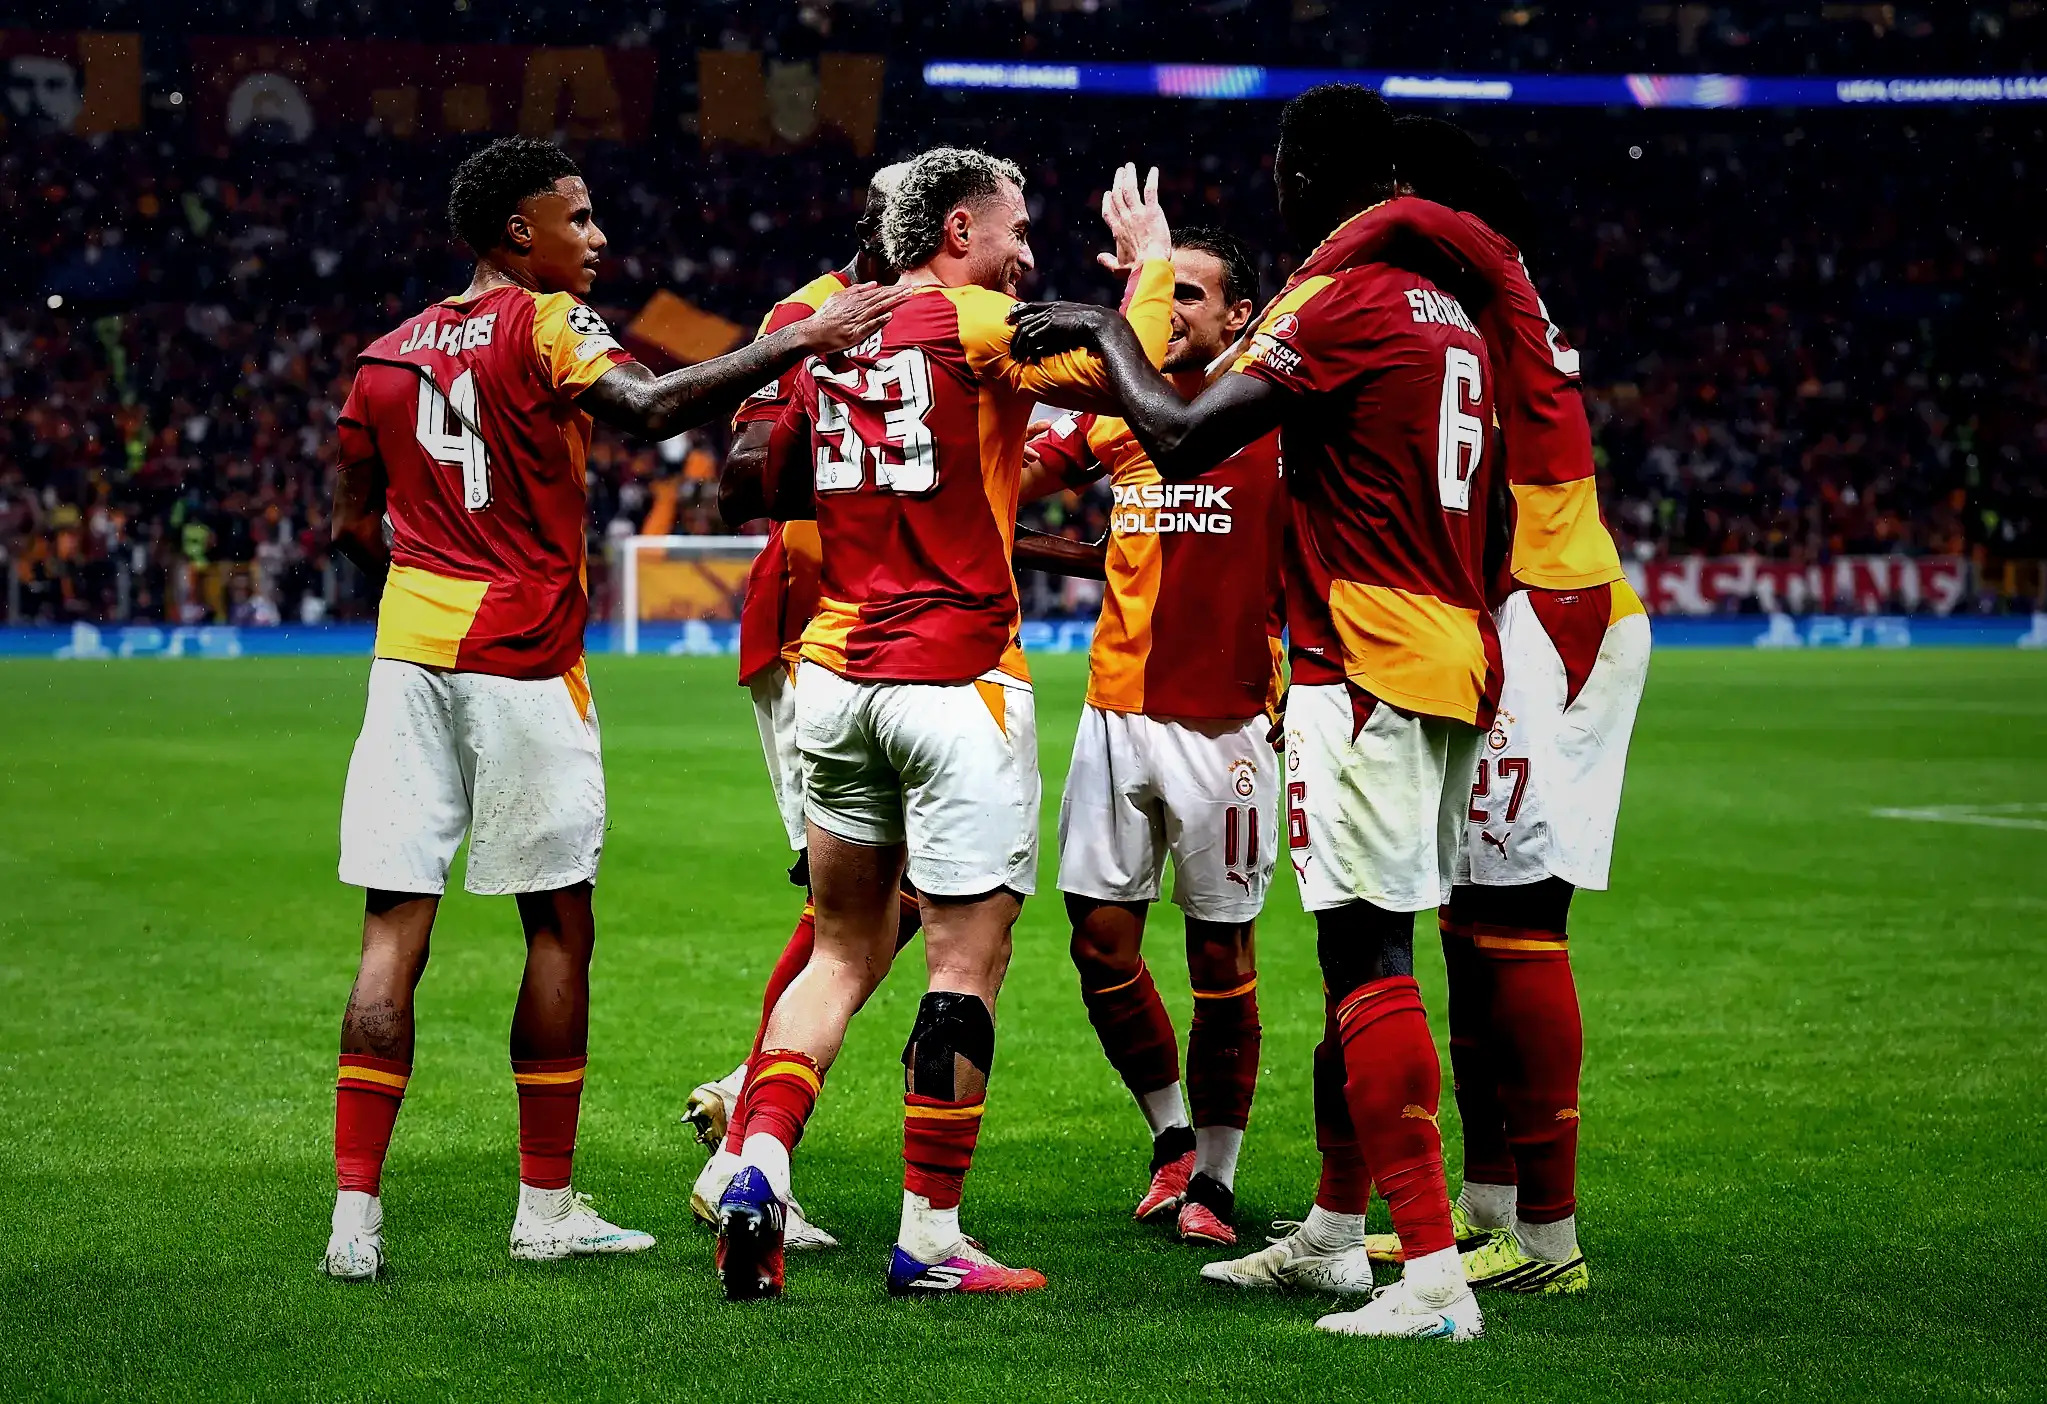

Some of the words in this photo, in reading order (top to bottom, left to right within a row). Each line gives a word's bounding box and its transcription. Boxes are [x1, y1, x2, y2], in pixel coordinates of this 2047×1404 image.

[415, 364, 494, 514] 4
[815, 346, 940, 497] 53
[1437, 346, 1485, 516] 6
[1020, 621, 1095, 655] PS
[1287, 781, 1312, 850] 6
[1468, 757, 1531, 824] 27
[1224, 806, 1260, 868] 11
